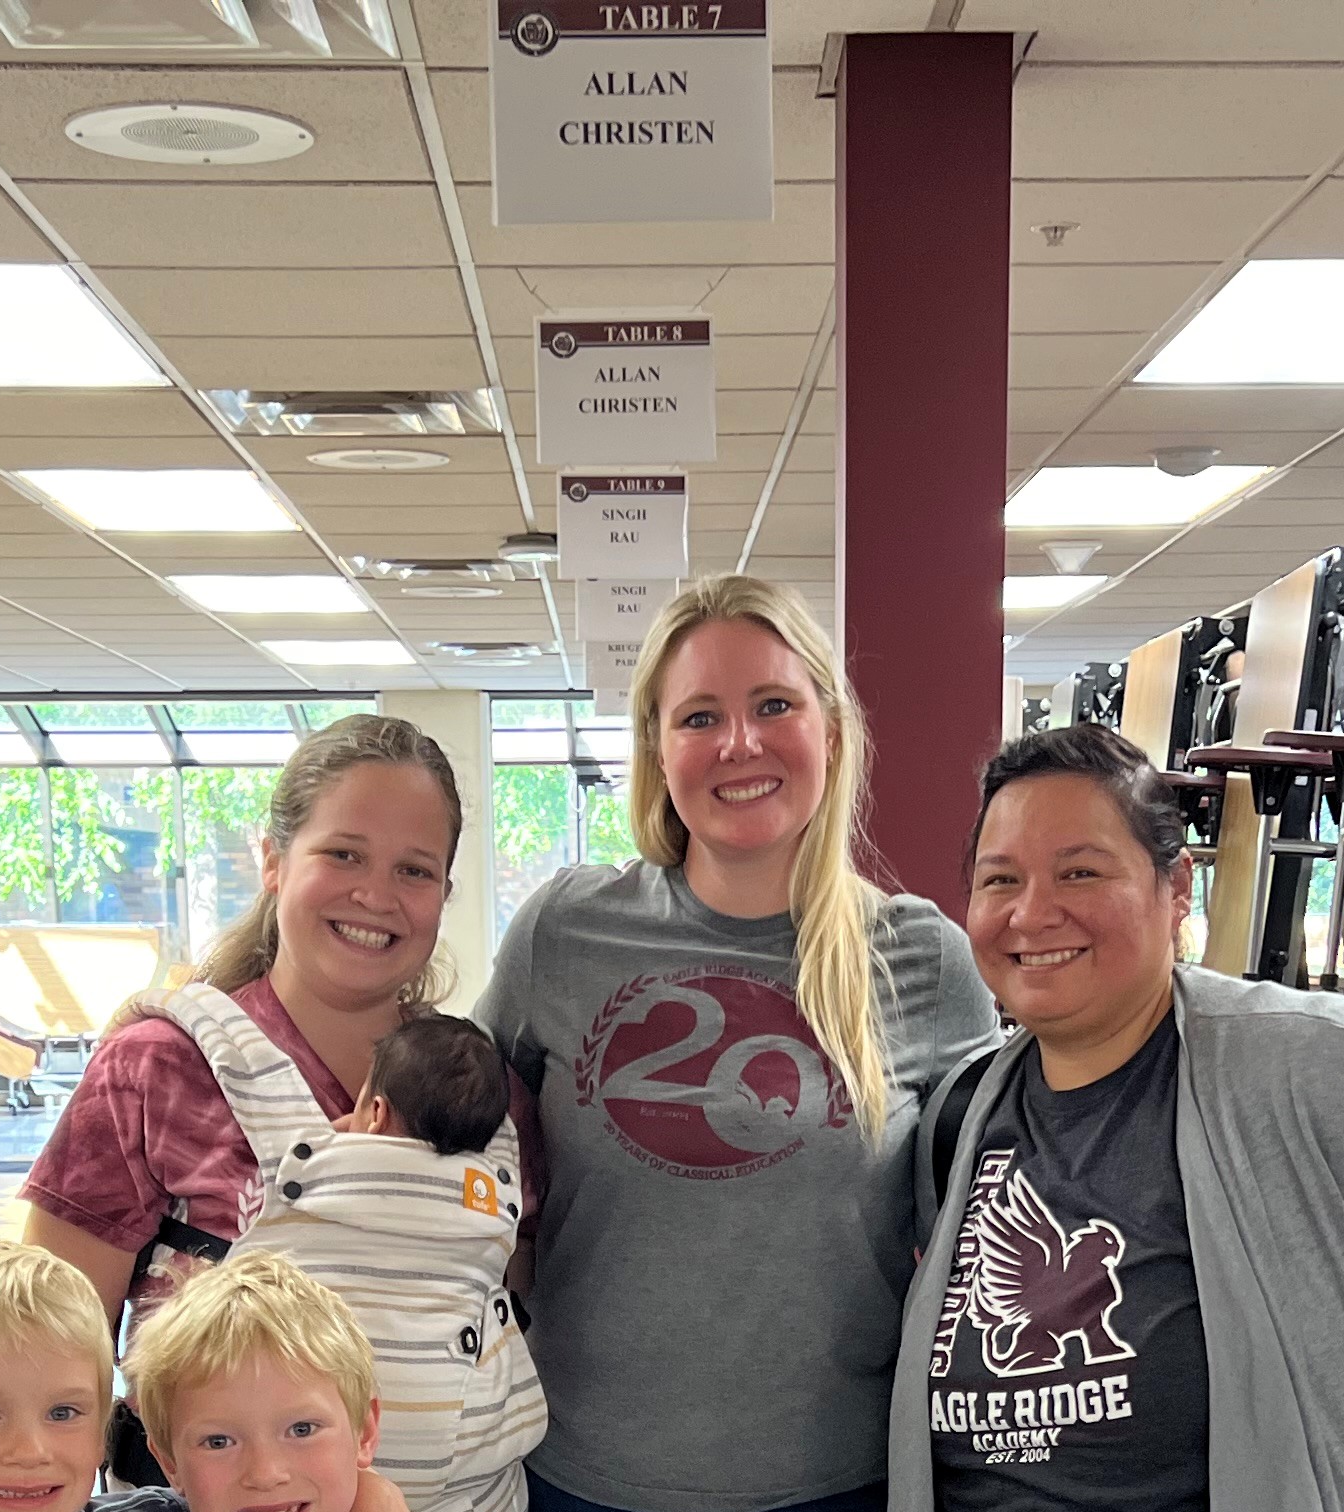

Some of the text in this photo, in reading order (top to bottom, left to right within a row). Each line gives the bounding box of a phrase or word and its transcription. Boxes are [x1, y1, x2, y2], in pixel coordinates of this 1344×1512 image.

[600, 5, 722, 31] TABLE 7
[584, 71, 688, 96] ALLAN
[559, 120, 715, 145] CHRISTEN
[604, 324, 683, 343] TABLE 8
[593, 366, 661, 383] ALLAN
[578, 397, 678, 414] CHRISTEN
[607, 479, 666, 492] TABLE 9
[601, 508, 647, 521] SINGH
[609, 531, 640, 543] RAU
[611, 586, 647, 595] SINGH
[617, 603, 641, 613] RAU
[615, 1132, 647, 1164] YEARS
[667, 1165, 735, 1181] CLASSICAL
[930, 1374, 1133, 1433] AGLE RIDGE
[972, 1428, 1062, 1453] ACADEMY
[985, 1447, 1051, 1465] EST. 2004
